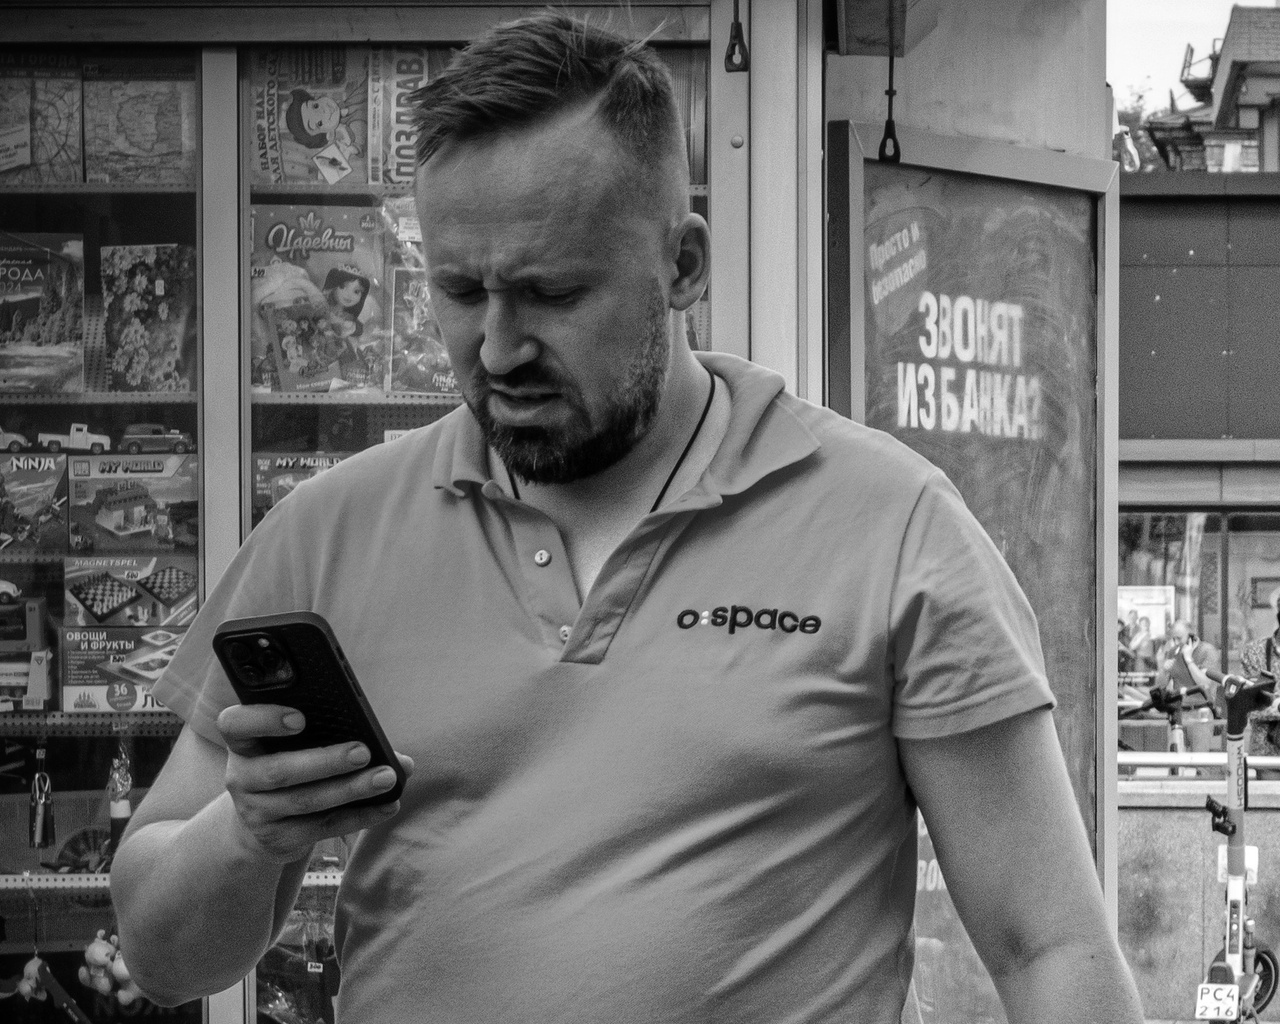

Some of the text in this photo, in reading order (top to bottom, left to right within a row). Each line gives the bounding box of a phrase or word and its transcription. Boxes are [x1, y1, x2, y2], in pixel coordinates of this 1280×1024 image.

[266, 80, 279, 153] ДЕТСКОГО
[395, 50, 424, 178] ПОЗДРАВ
[257, 124, 270, 172] НАБОР
[267, 222, 352, 258] Царевны
[869, 228, 910, 272] Просто
[919, 291, 1024, 368] ЗВОНЯТ
[897, 361, 1042, 440] ИЗ БАНКА?
[11, 456, 56, 472] NINJA
[99, 461, 121, 474] MY
[121, 460, 164, 474] WORLD
[275, 457, 298, 469] MY
[74, 560, 138, 568] MAGNETSPEL
[66, 631, 107, 642] ОВОЩИ
[80, 640, 135, 651] И ФРУКТЫ
[113, 683, 128, 697] 36
[1200, 987, 1235, 1001] PC4
[1199, 1005, 1234, 1017] 216
